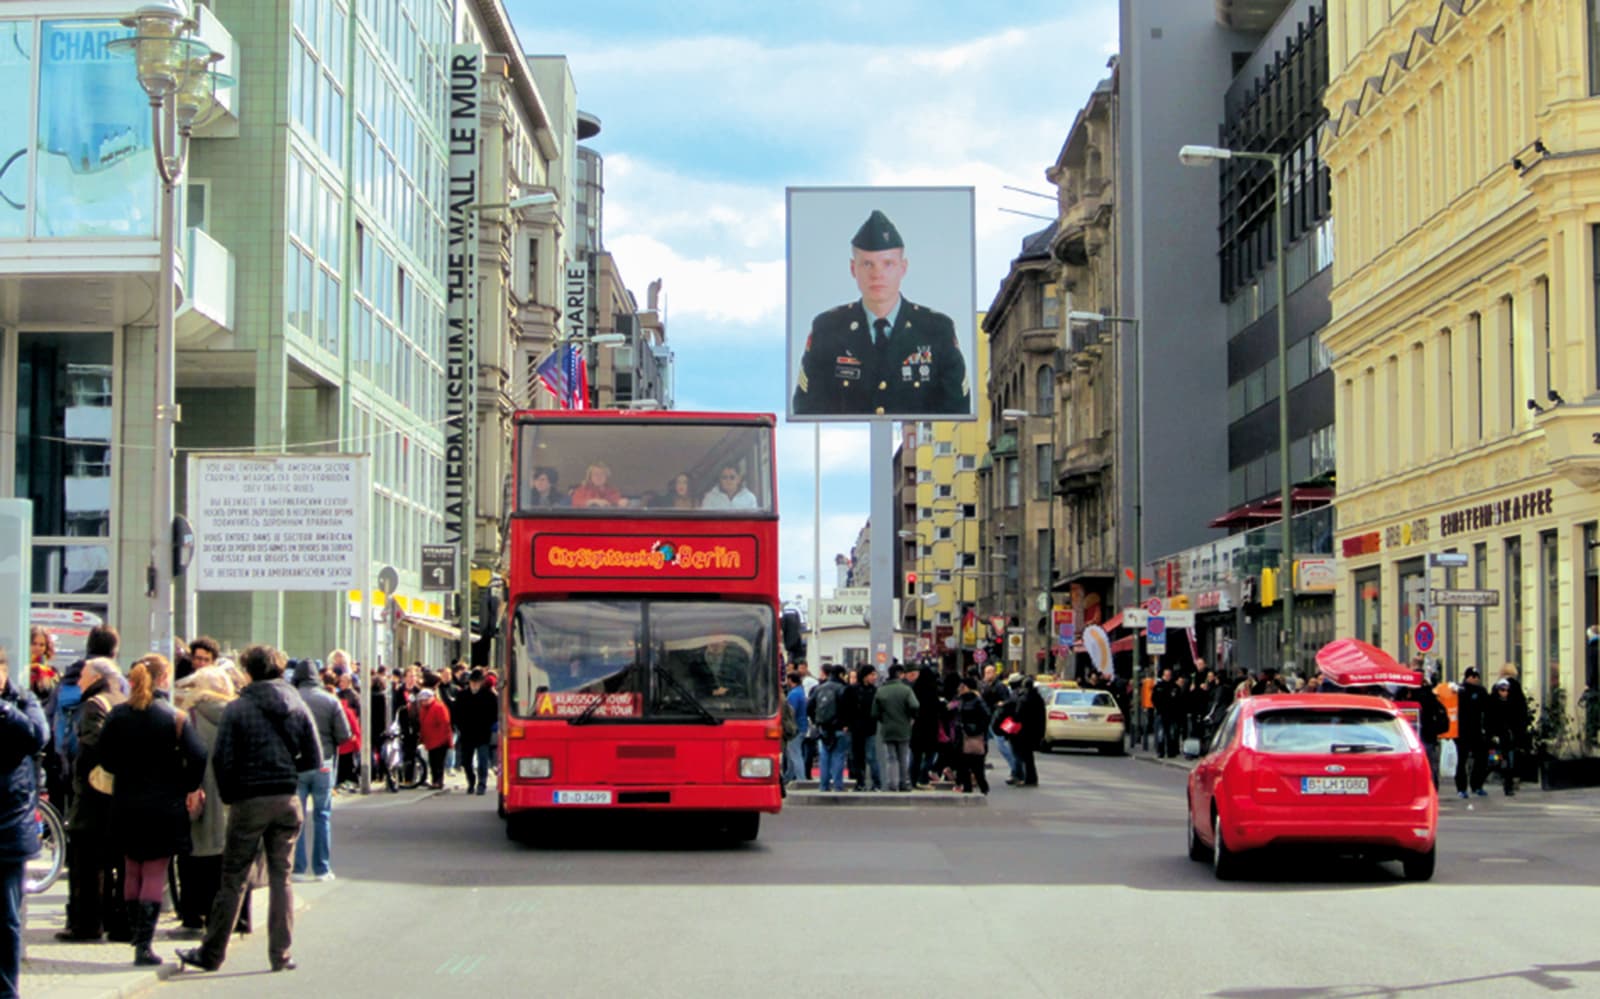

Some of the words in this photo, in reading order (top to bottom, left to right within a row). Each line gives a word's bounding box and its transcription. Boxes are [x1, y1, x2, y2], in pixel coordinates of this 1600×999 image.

[50, 31, 135, 60] CHAR
[451, 54, 477, 118] MUR
[451, 128, 475, 154] LE
[450, 170, 475, 245] WALL
[448, 254, 473, 303] THE
[1503, 488, 1554, 524] KAFFEE
[679, 545, 741, 568] Berlin
[540, 693, 554, 714] A
